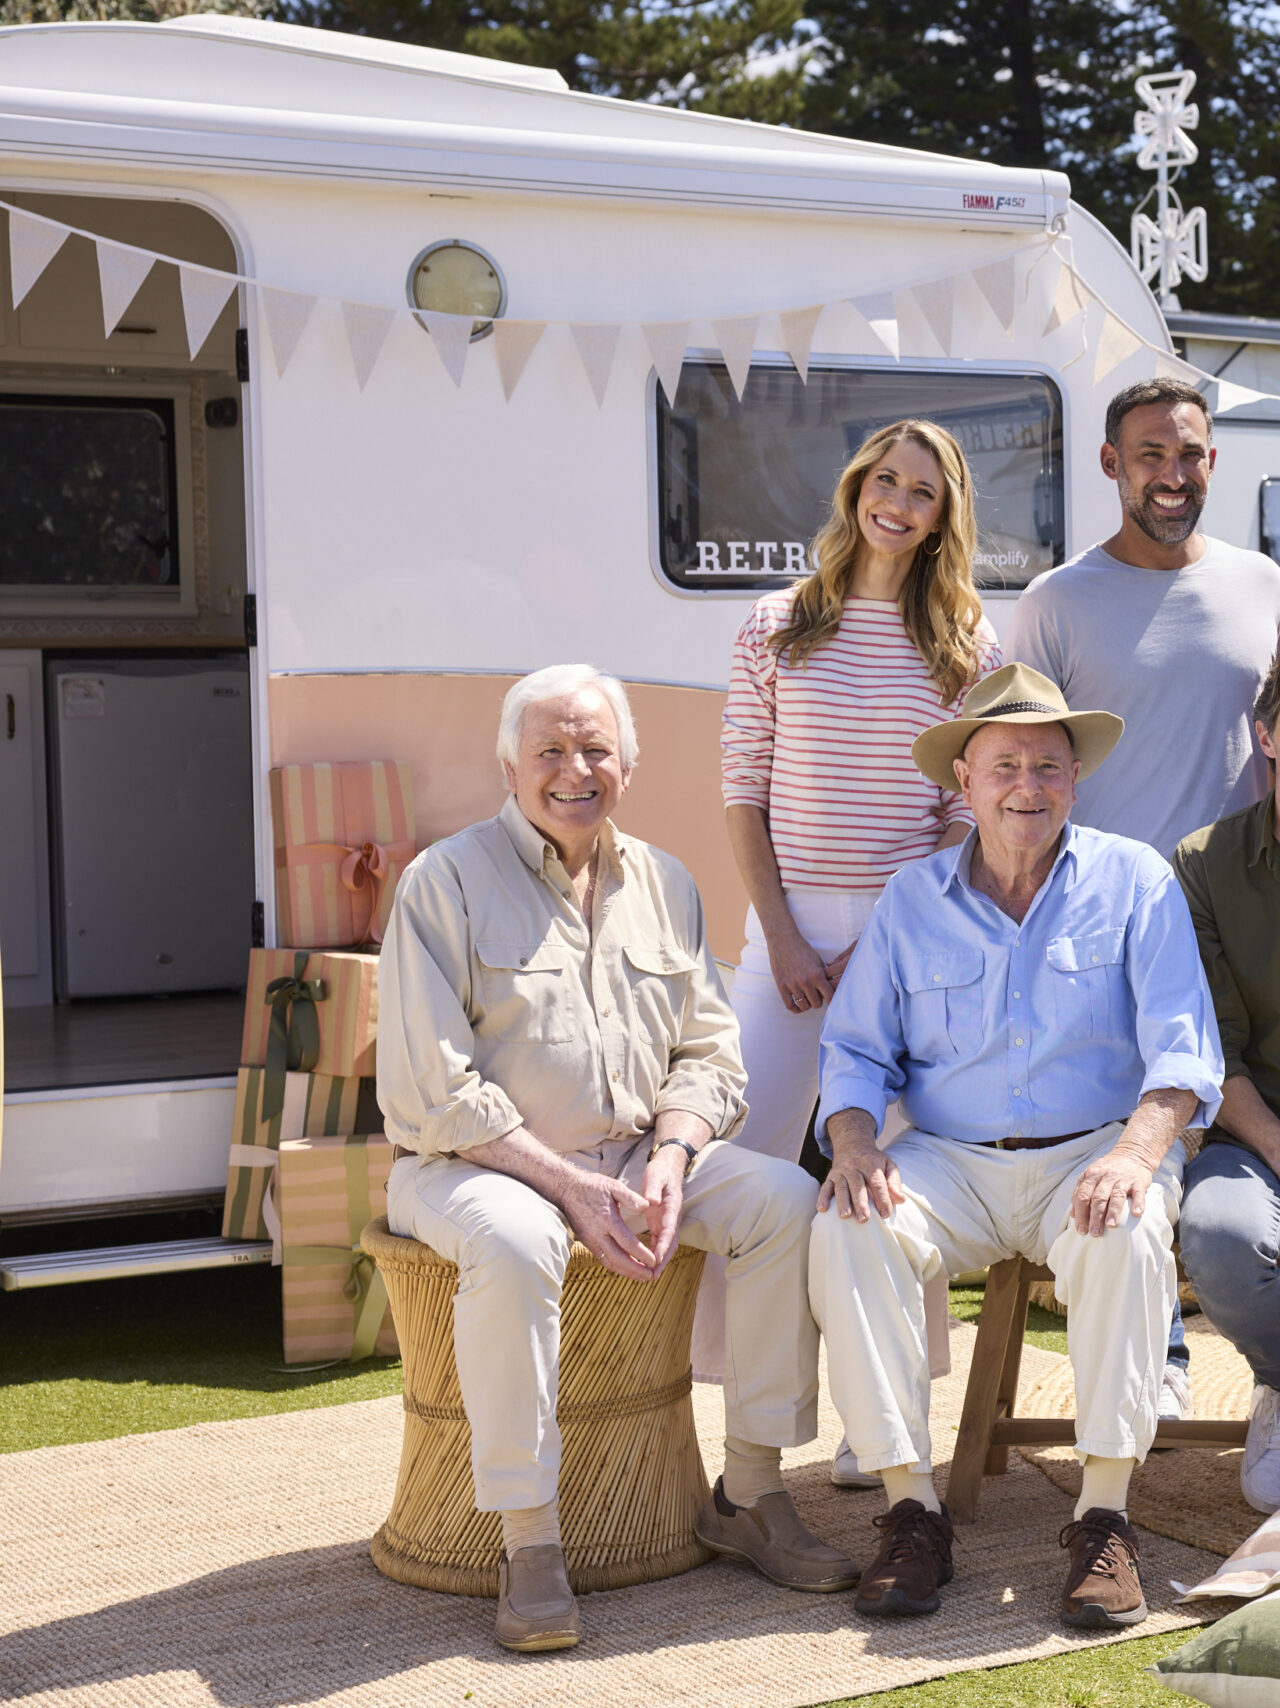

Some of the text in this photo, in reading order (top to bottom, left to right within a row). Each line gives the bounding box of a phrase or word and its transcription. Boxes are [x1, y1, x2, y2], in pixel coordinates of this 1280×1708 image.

[962, 194, 995, 210] FIAMMA
[695, 541, 821, 573] RETR
[971, 551, 1029, 569] amplify
